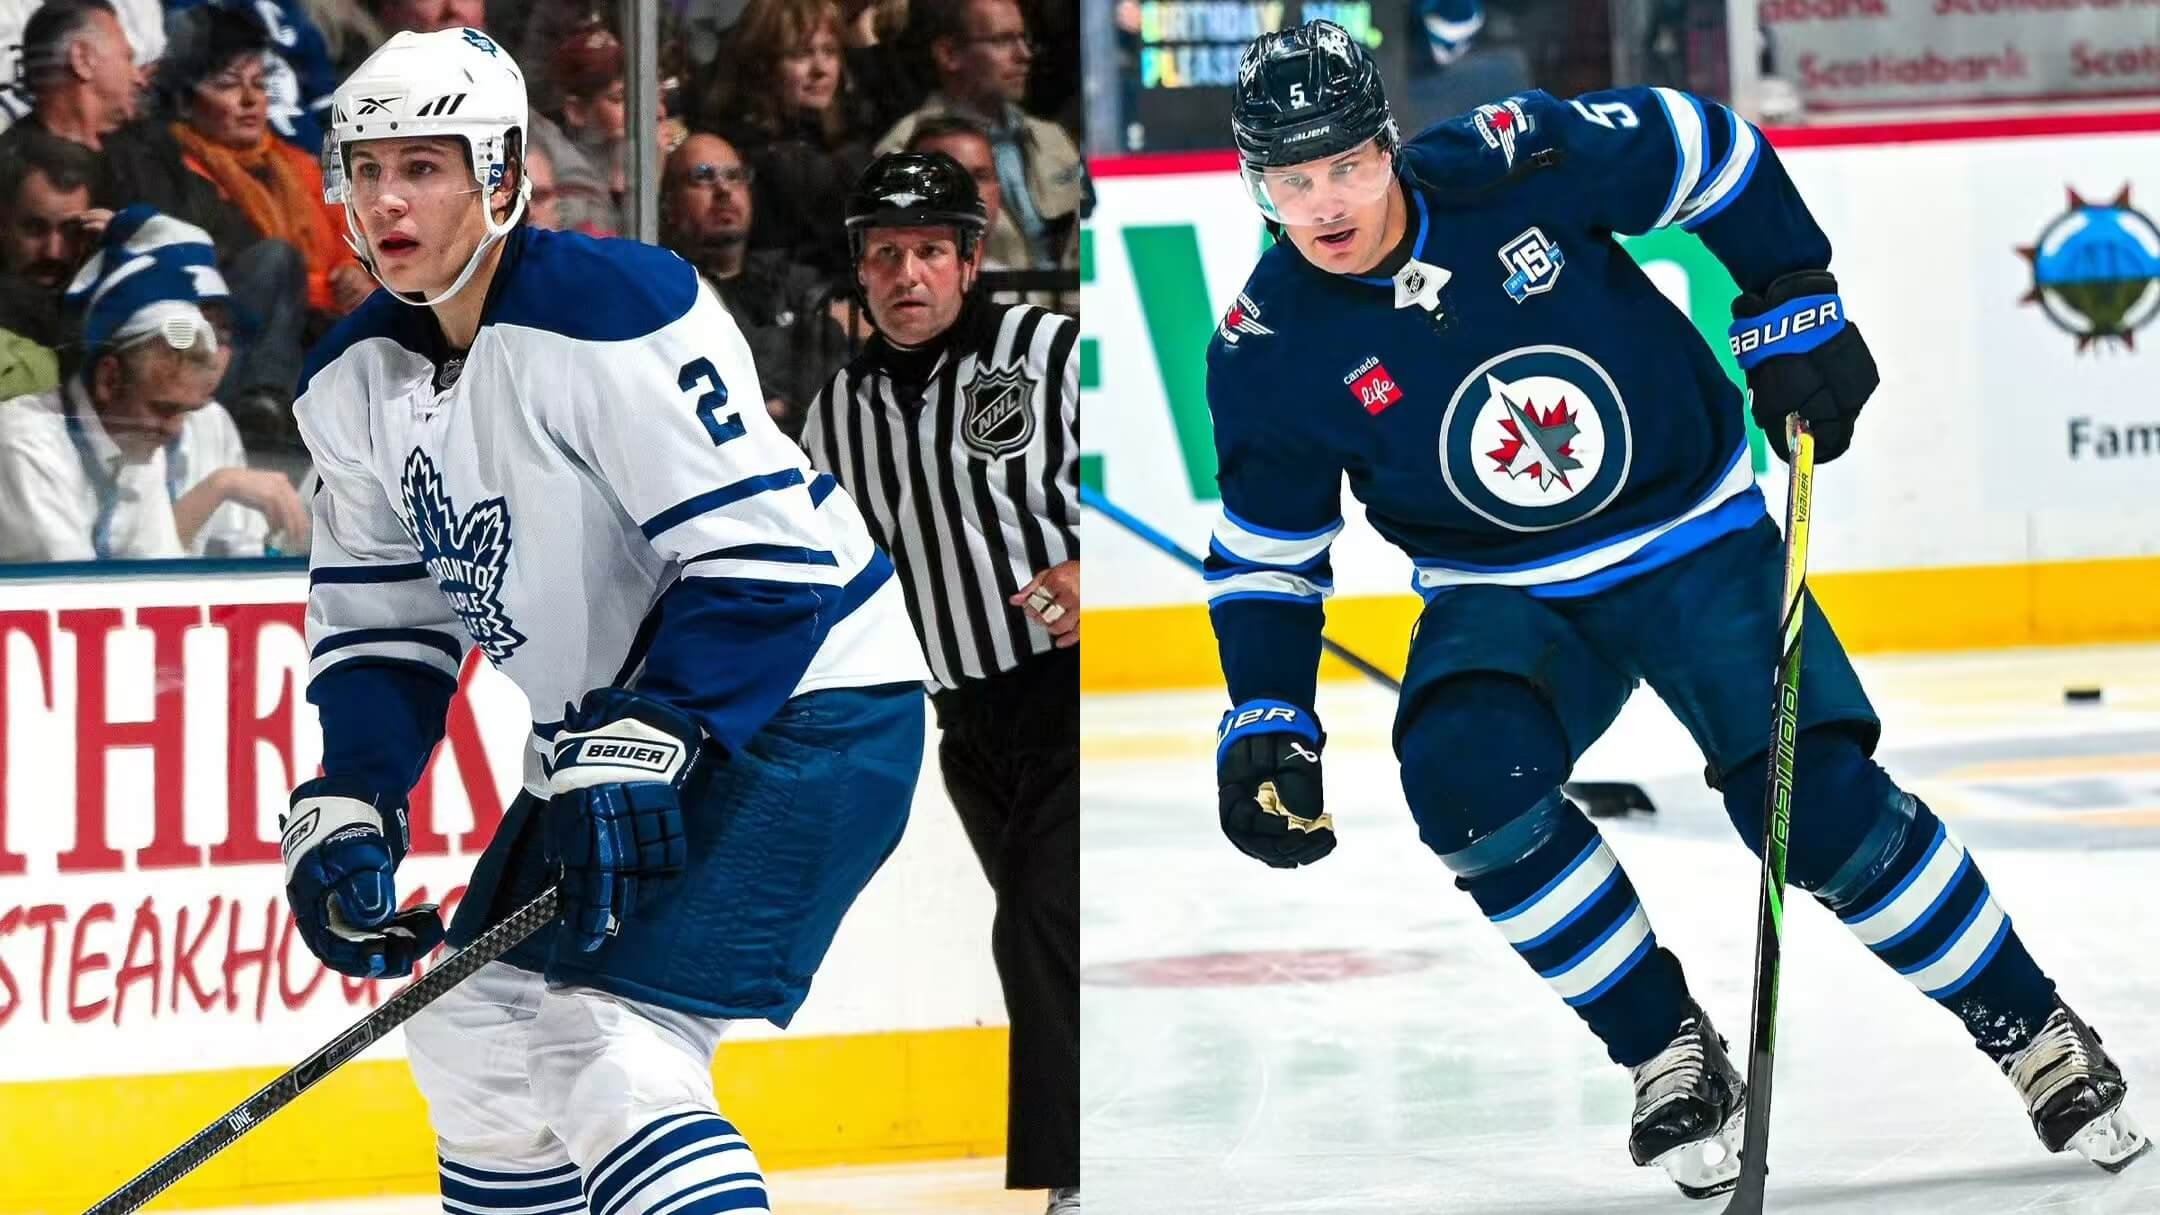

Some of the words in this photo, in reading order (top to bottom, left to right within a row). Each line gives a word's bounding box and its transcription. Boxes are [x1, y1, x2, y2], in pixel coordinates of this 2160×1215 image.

[1141, 46, 1242, 88] PLEAS
[1798, 44, 2030, 90] Scotiabank
[1290, 83, 1305, 109] 5
[1512, 239, 1552, 283] 15
[1343, 356, 1379, 385] canada
[677, 356, 747, 447] 2
[978, 392, 1017, 435] NHL
[1361, 378, 1395, 407] life
[1217, 707, 1296, 749] UER
[0, 885, 470, 1028] STEAKHO
[228, 1107, 255, 1132] ONE
